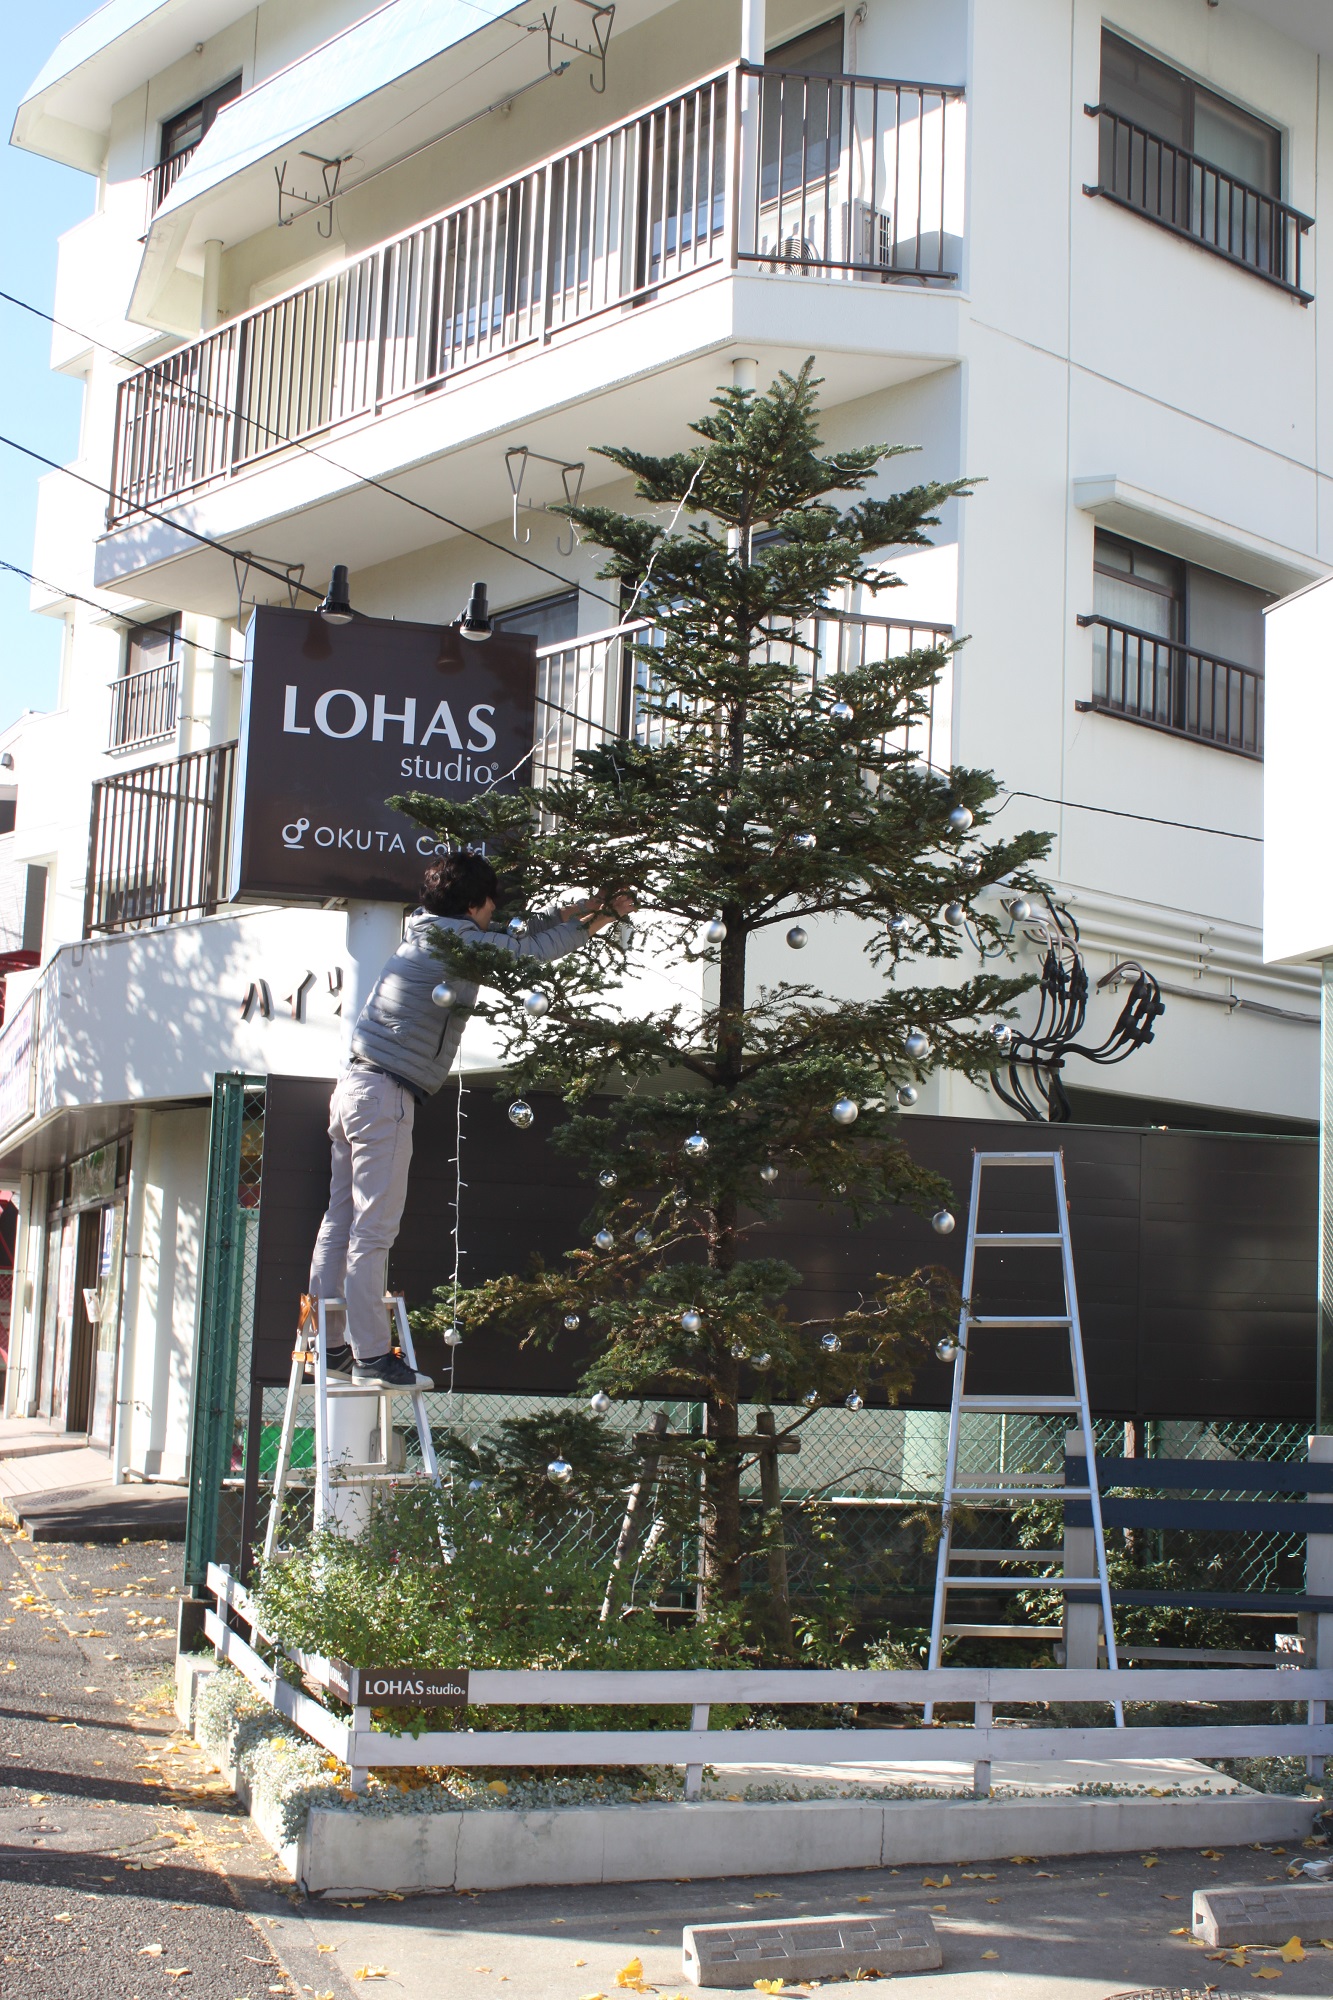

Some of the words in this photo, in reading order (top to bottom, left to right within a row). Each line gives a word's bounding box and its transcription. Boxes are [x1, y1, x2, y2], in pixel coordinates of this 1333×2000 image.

[283, 685, 496, 752] LOHAS
[314, 826, 406, 854] OKUTA
[364, 1680, 424, 1695] LOHAS
